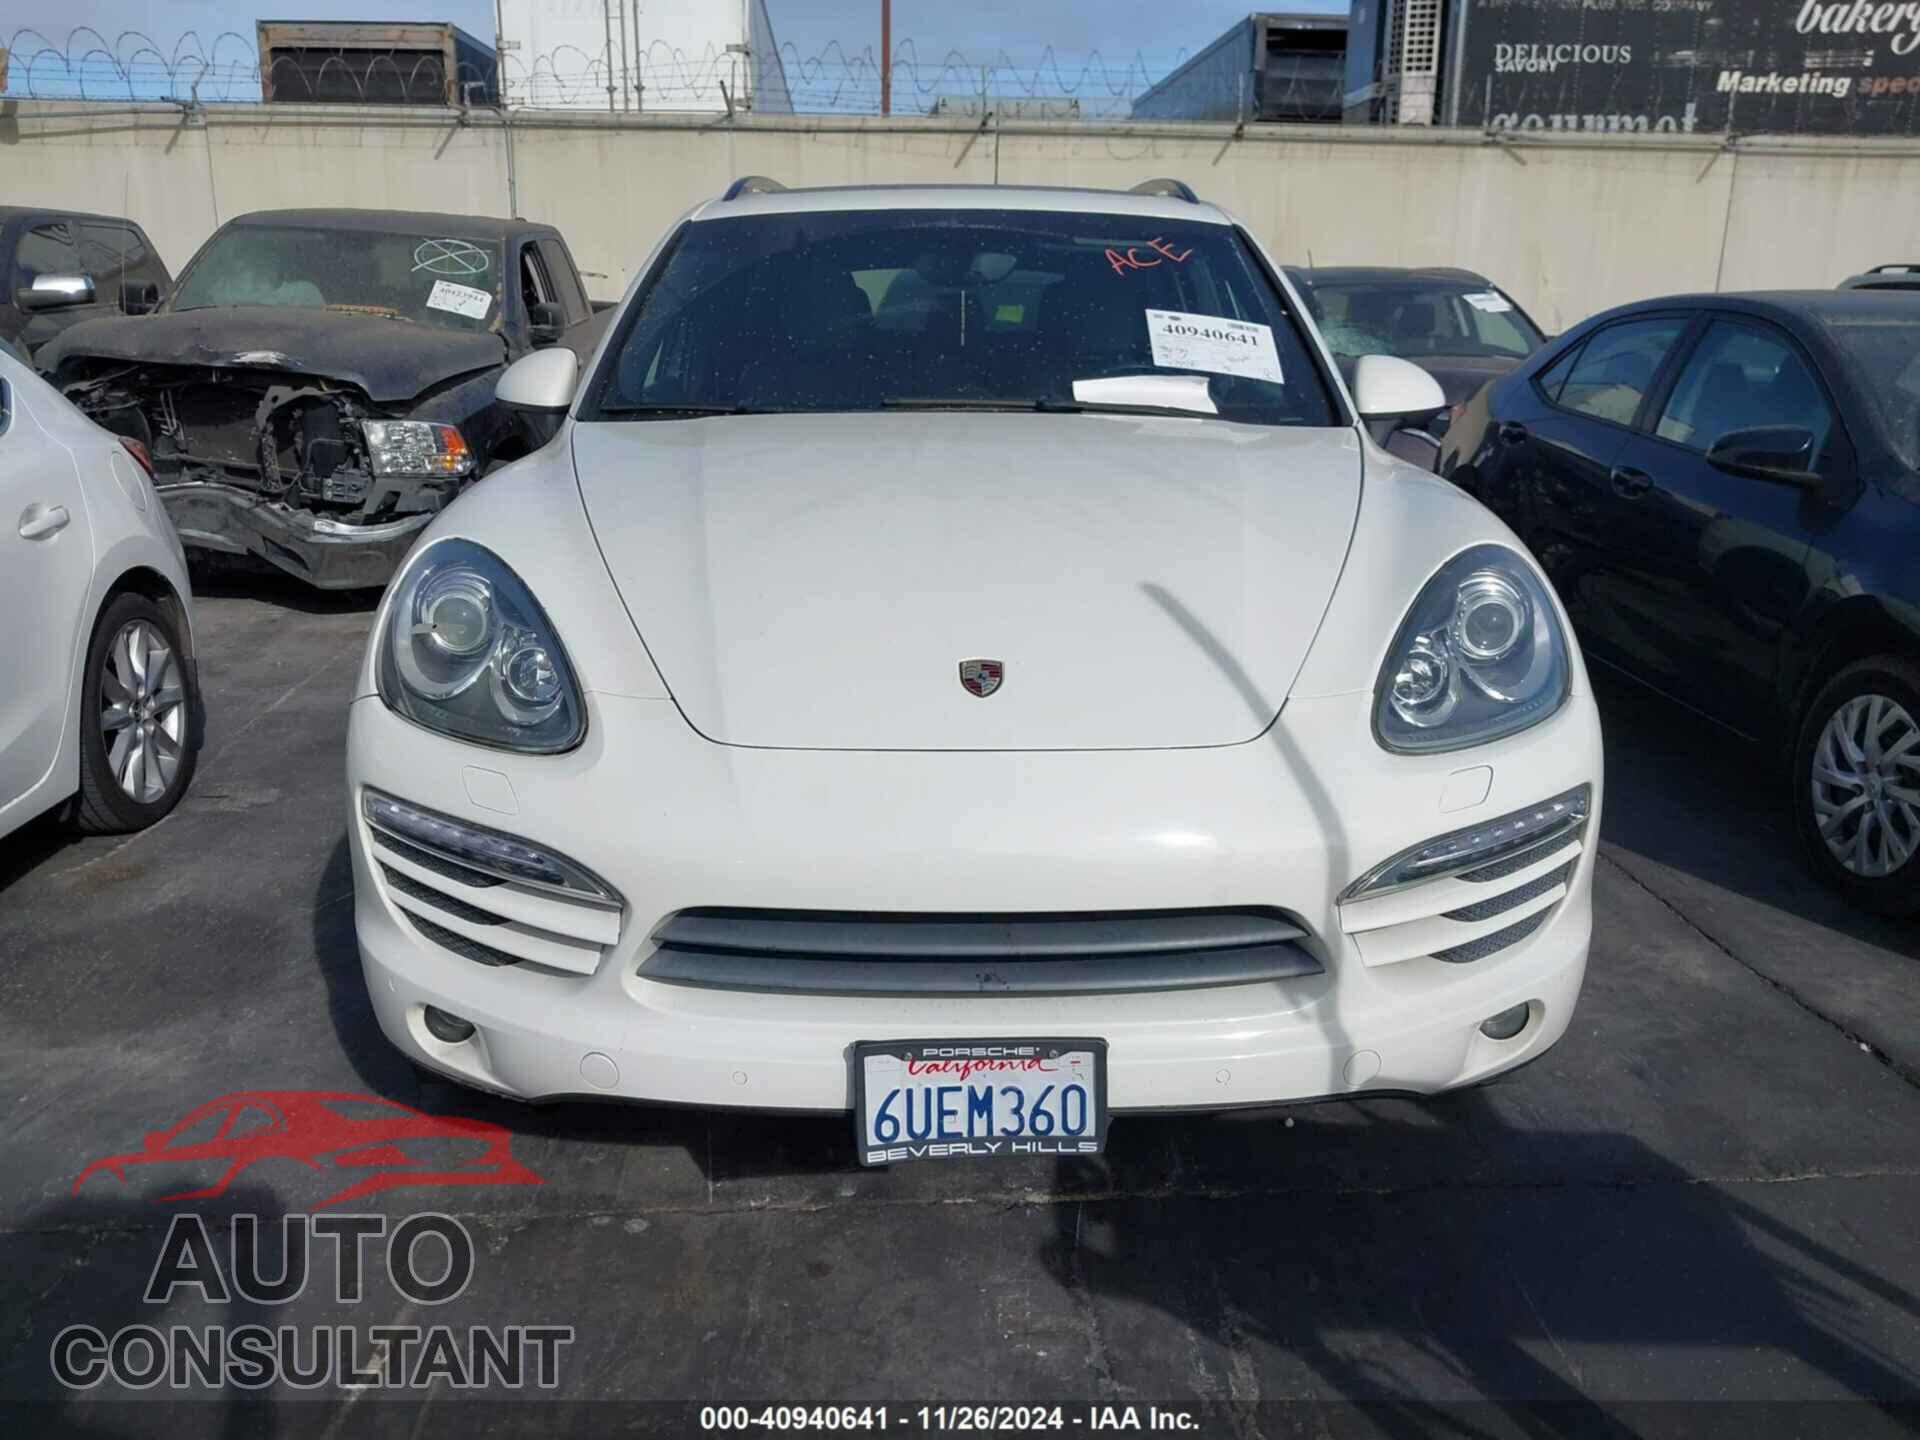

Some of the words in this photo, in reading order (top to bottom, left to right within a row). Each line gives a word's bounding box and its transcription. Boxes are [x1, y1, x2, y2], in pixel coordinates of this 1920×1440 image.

[1495, 44, 1632, 64] DELICIOUS
[1495, 60, 1560, 72] SAVORY
[1716, 71, 1852, 98] Marketing
[1105, 236, 1193, 276] ACE
[1162, 324, 1258, 346] 40940641
[874, 1084, 1088, 1143] 6UEM360
[867, 1142, 1003, 1163] BEVERLY
[1012, 1142, 1098, 1153] HILLS
